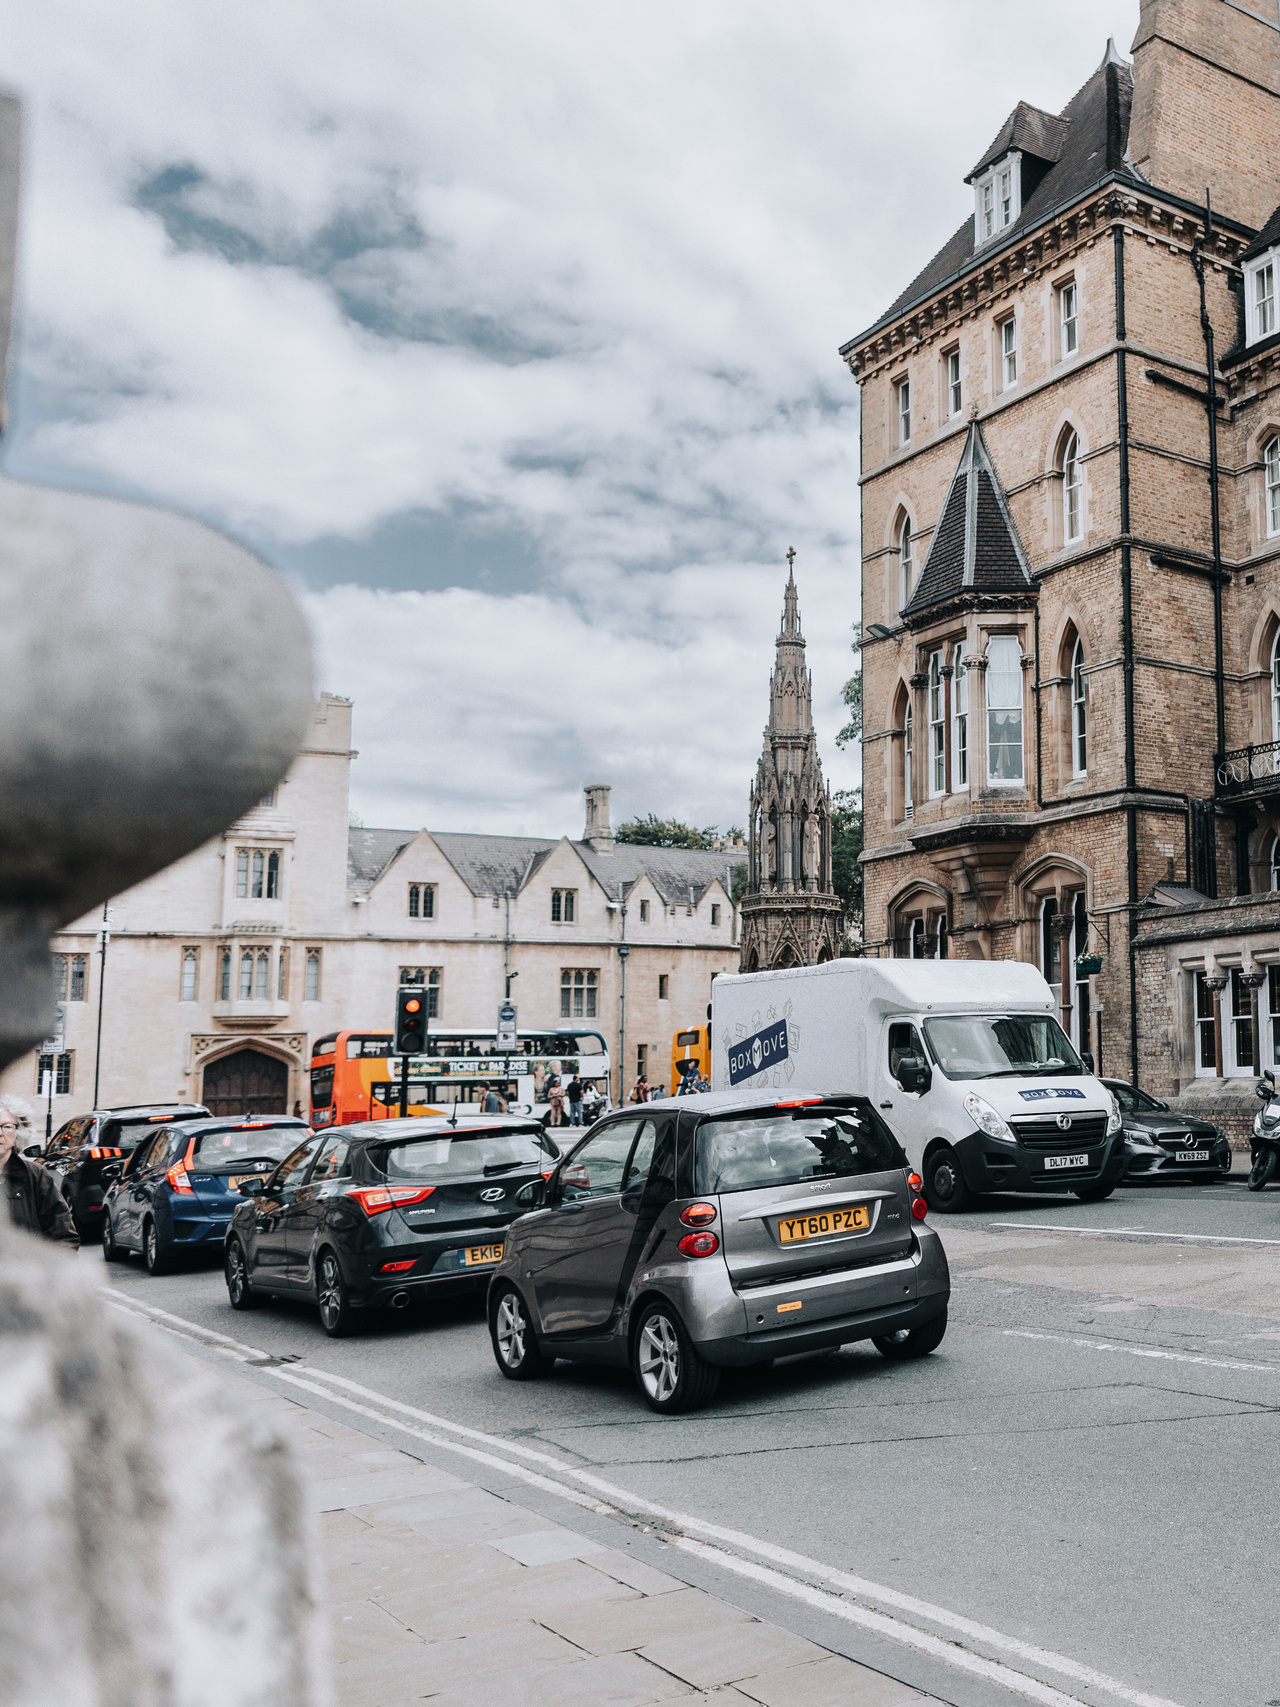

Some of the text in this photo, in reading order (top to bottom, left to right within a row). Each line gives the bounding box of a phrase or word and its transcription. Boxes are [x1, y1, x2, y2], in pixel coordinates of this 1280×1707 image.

[731, 1031, 786, 1074] BOXMOVE
[449, 1062, 479, 1071] TICKET
[489, 1061, 528, 1071] PARDISE
[1050, 1157, 1068, 1167] DL17
[810, 1182, 831, 1192] smart
[785, 1215, 829, 1238] YT60
[832, 1209, 863, 1230] PZC
[470, 1245, 502, 1262] EK16
